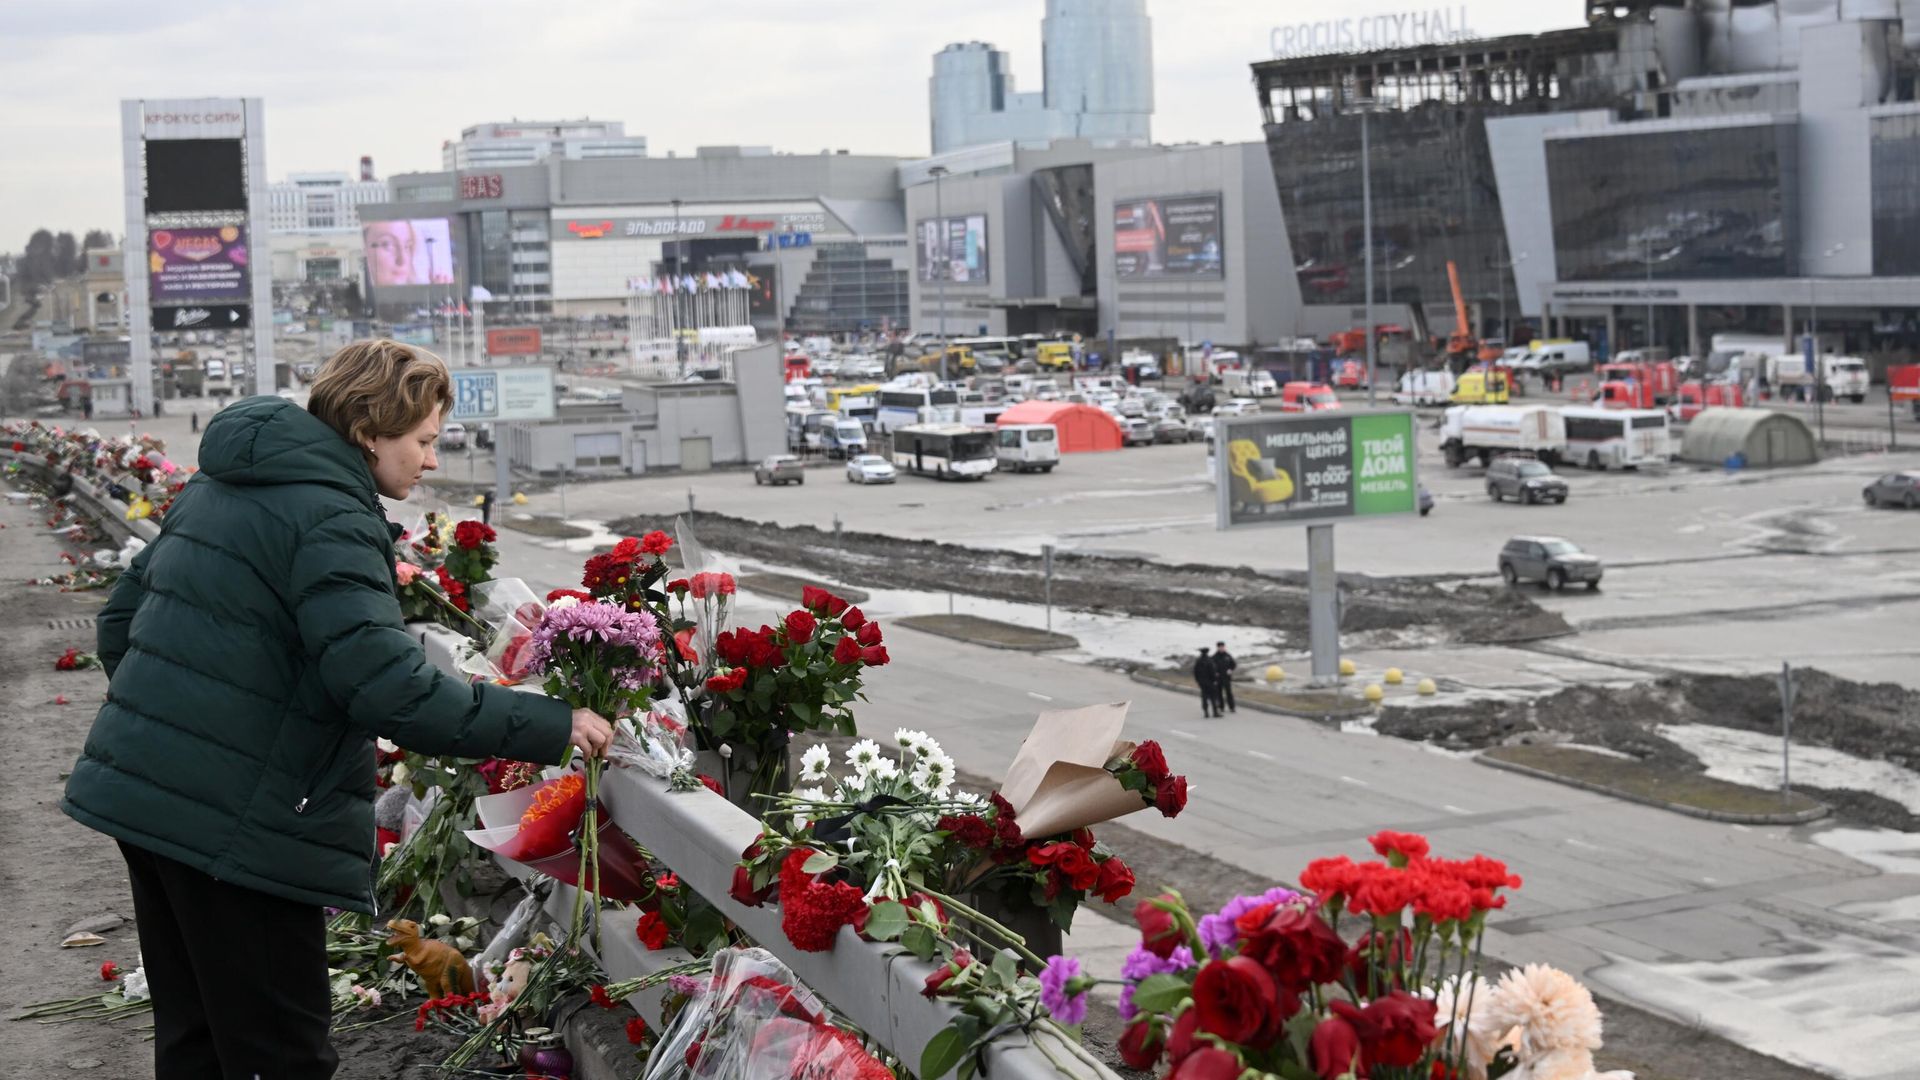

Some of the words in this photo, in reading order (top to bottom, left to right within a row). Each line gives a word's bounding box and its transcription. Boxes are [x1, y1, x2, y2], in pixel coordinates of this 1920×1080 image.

[1271, 18, 1354, 58] CROCUS
[1360, 14, 1407, 49] CITY
[1412, 5, 1473, 47] HALL
[145, 113, 201, 124] КРОКУС
[205, 112, 241, 123] СИТИ
[783, 214, 825, 223] CROCUS
[625, 219, 706, 236] ЭЛЬДОРАДО
[1266, 427, 1347, 448] МЕБЕЛЬНЫЙ
[1361, 434, 1405, 457] ТВОЙ
[1306, 443, 1347, 460] ЦЕНТР
[1361, 455, 1407, 478] ДОМ
[1304, 472, 1321, 487] 30
[1361, 479, 1408, 494] МЕБЕЛЬ
